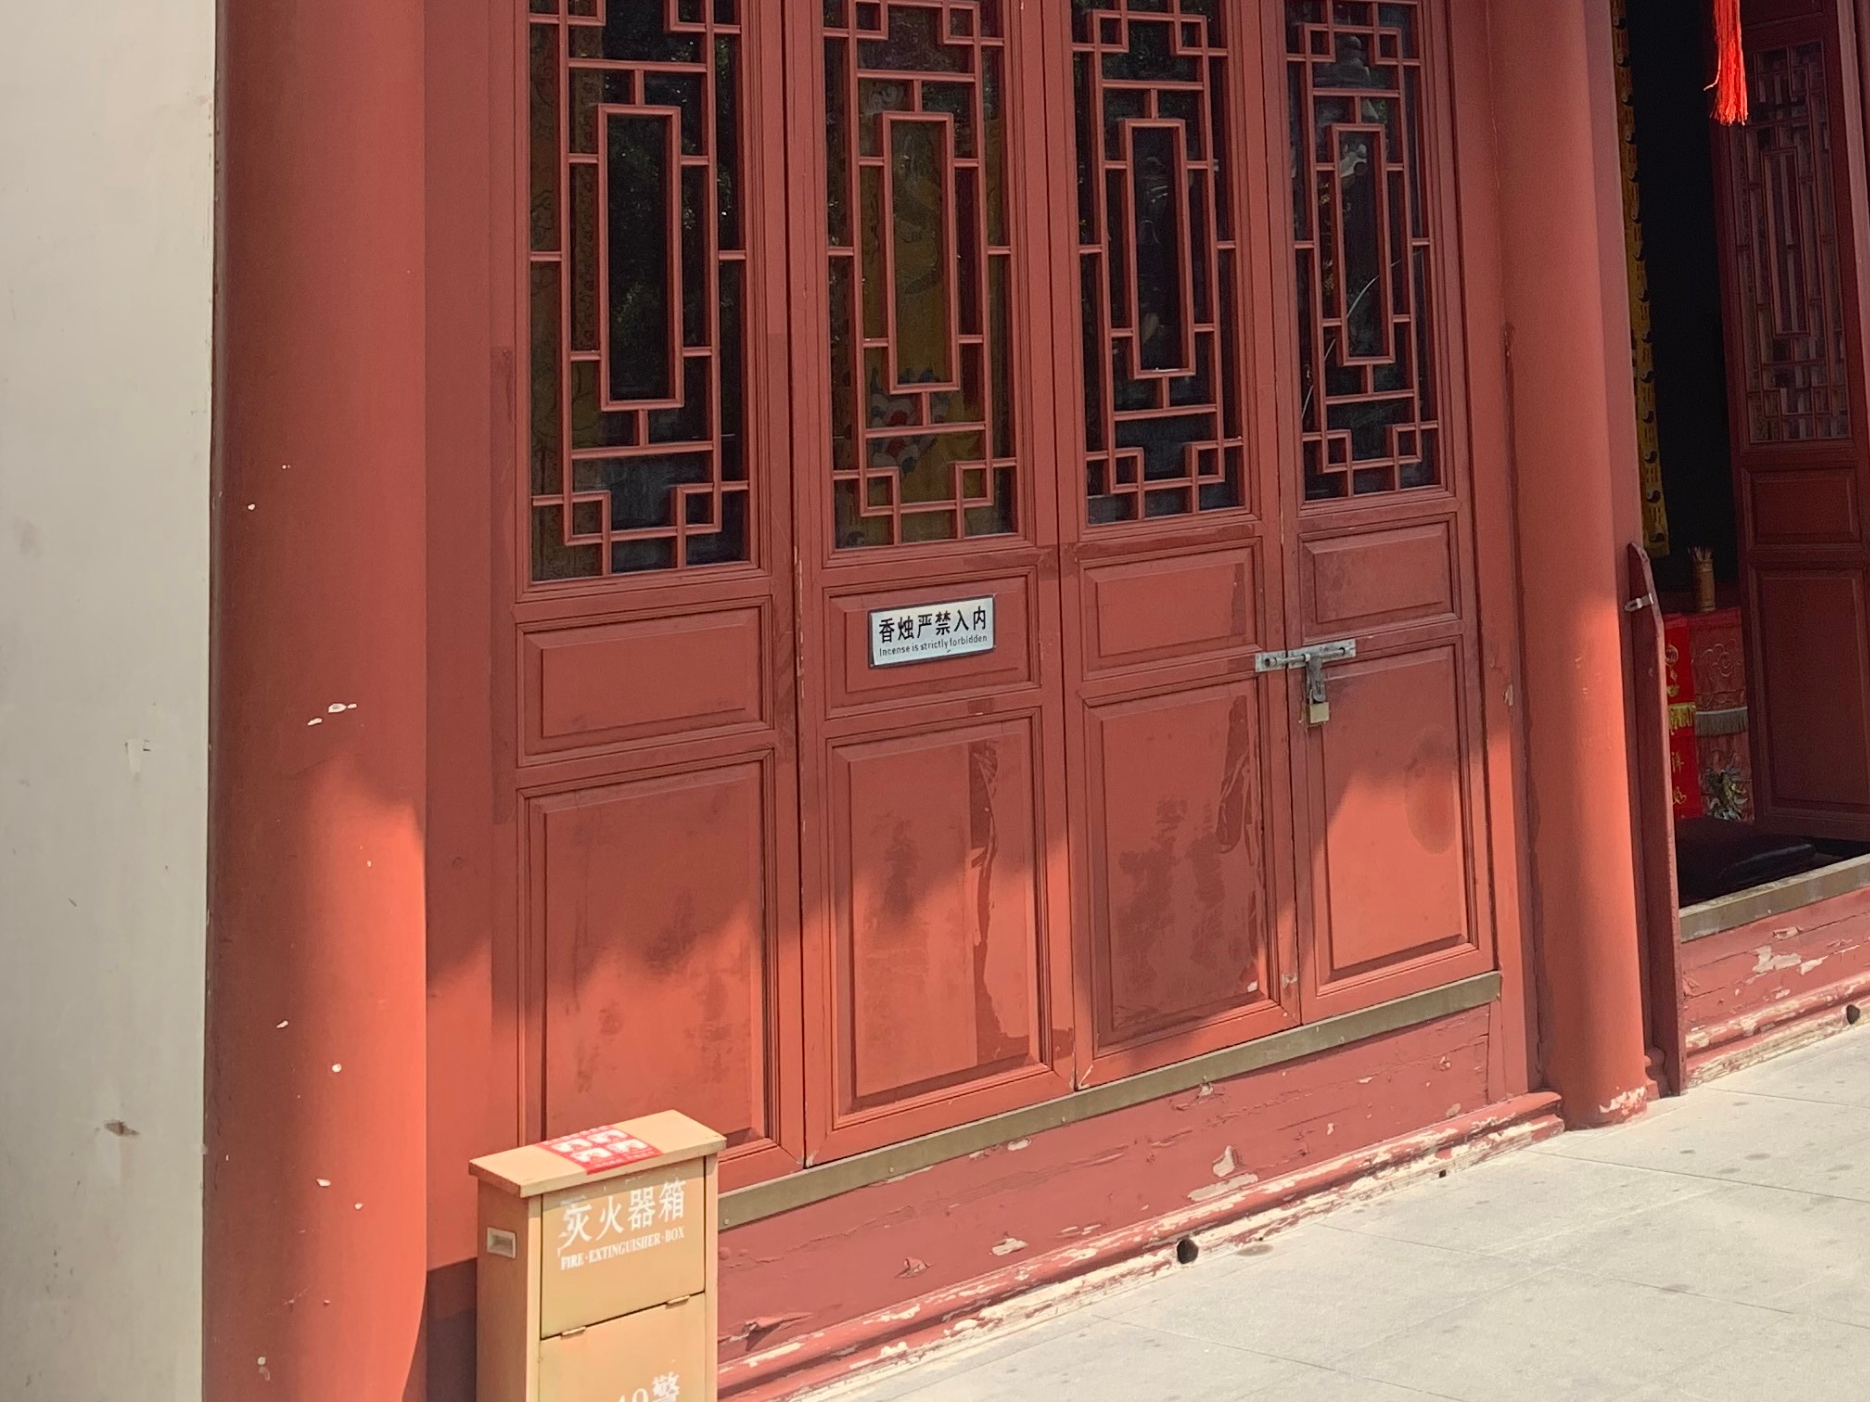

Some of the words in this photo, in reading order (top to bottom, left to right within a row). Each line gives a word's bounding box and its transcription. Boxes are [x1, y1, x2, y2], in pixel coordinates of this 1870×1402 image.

[879, 606, 987, 643] 香烛严禁入内
[879, 645, 910, 657] Incense
[912, 643, 919, 652] is
[920, 639, 949, 651] strictly
[557, 1178, 687, 1254] 灭火器箱
